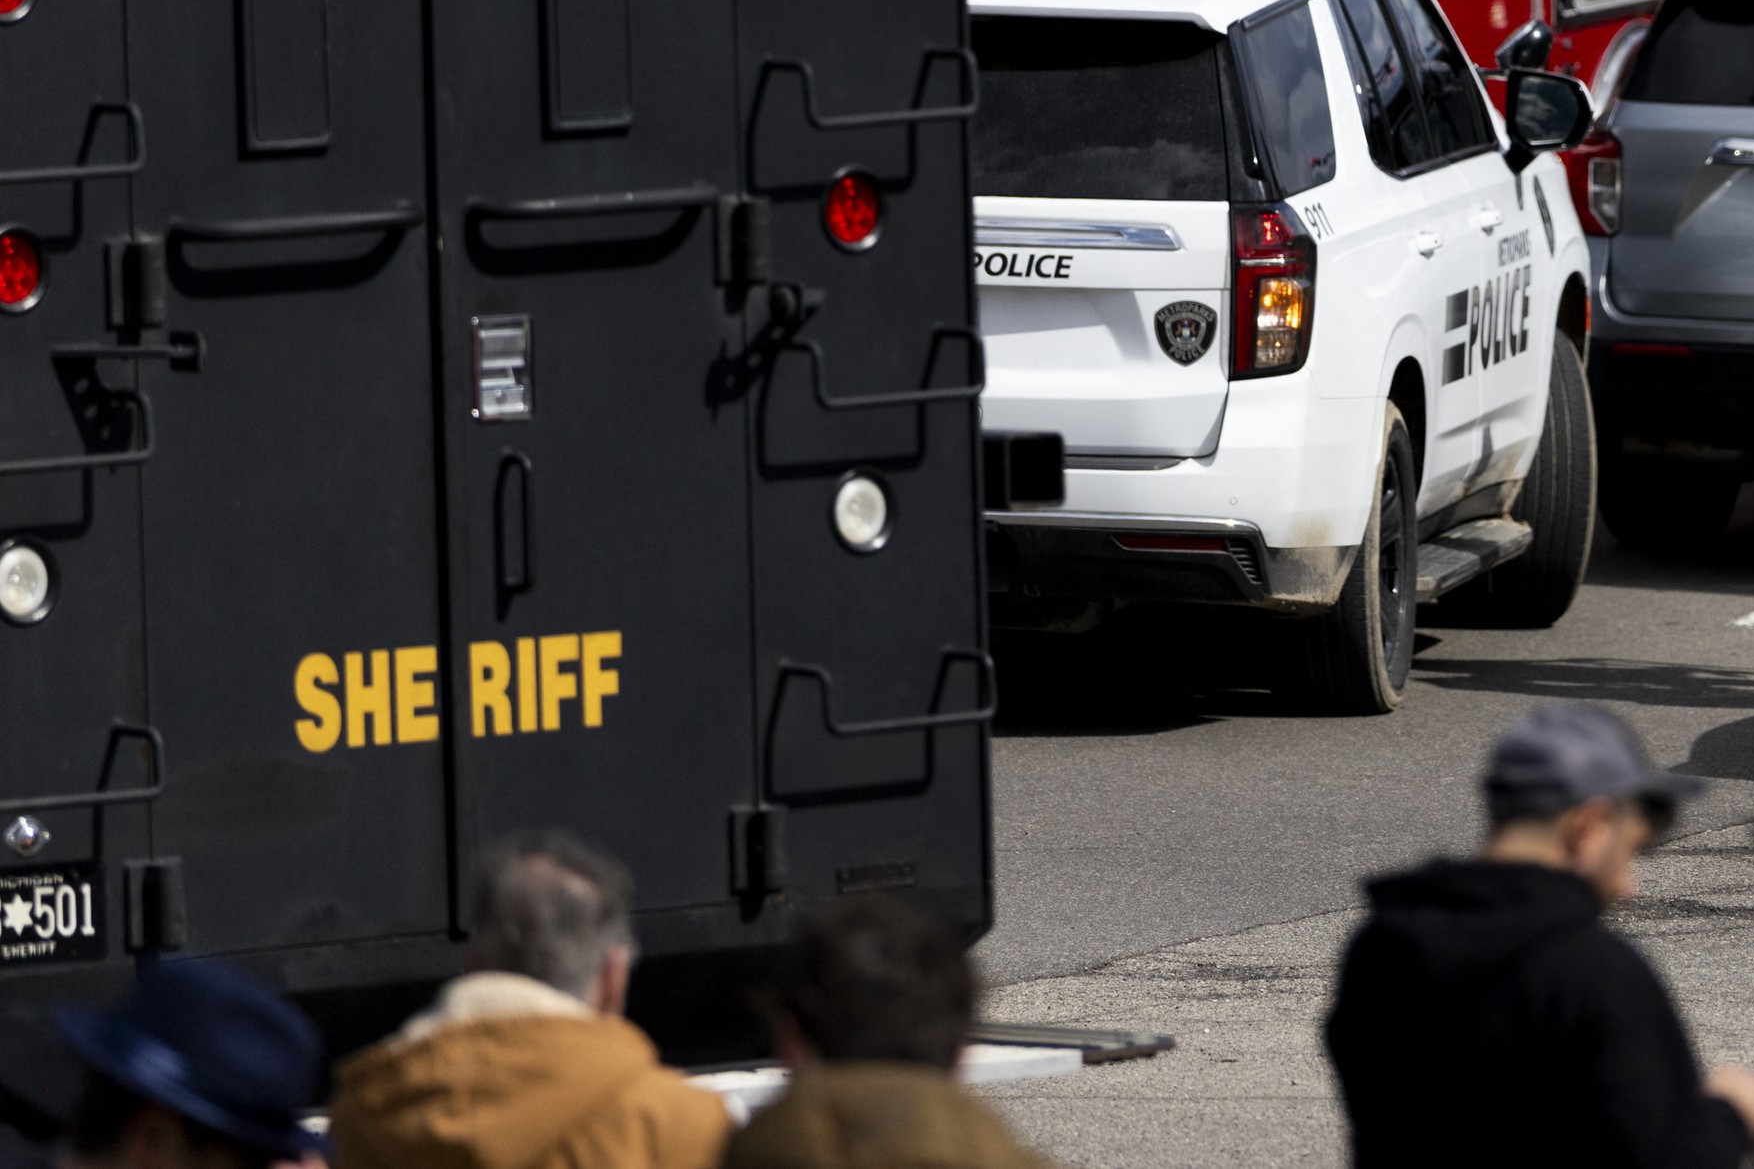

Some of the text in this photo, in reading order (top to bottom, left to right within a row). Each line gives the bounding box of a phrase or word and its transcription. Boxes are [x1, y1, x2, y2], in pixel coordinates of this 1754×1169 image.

[1304, 202, 1335, 240] 911
[1158, 302, 1216, 323] METROPARKS
[1468, 264, 1532, 377] POLICE
[1169, 344, 1207, 361] POLICE
[1, 940, 57, 961] SHERIFF
